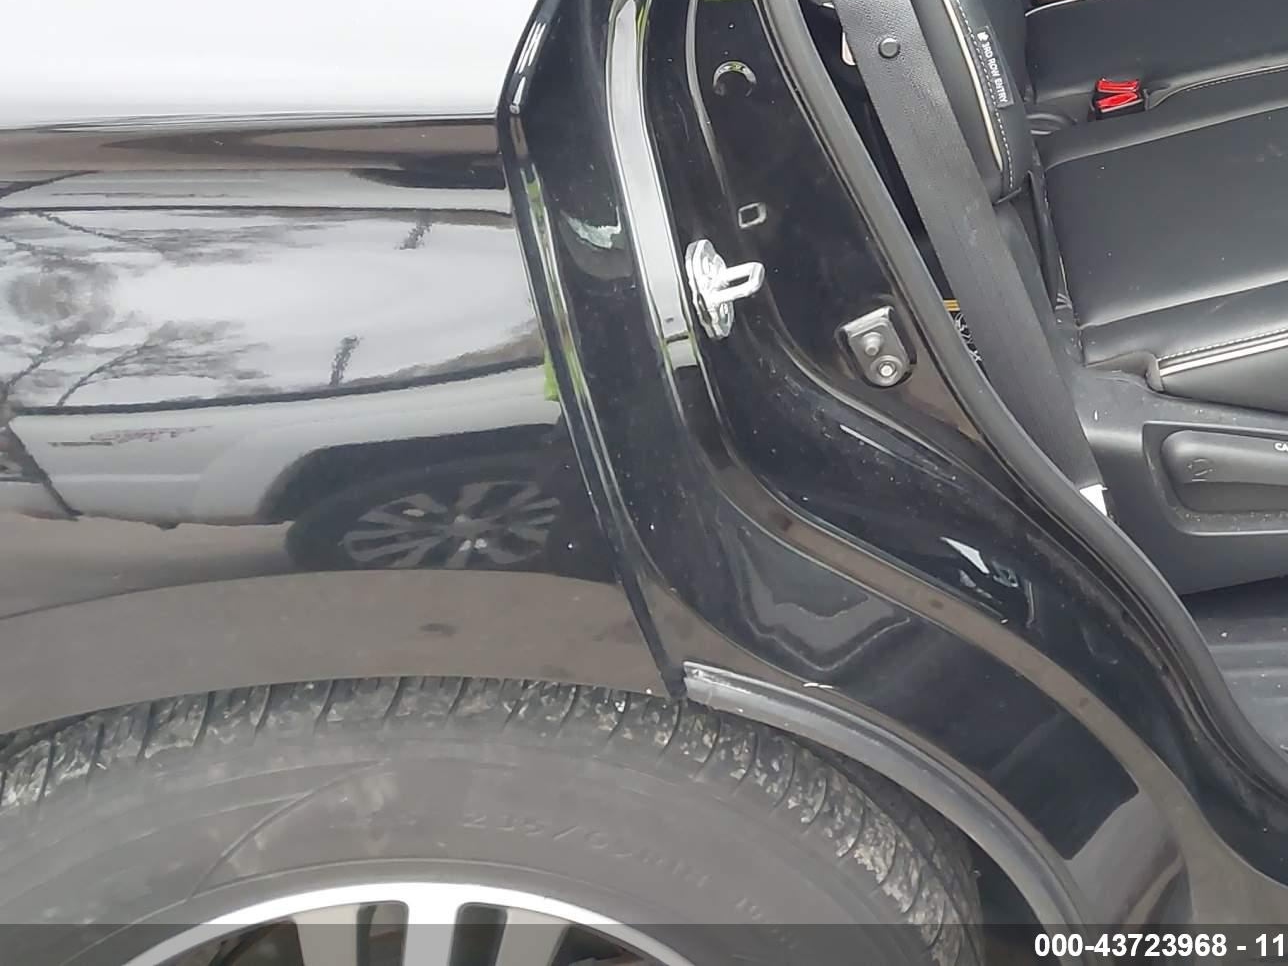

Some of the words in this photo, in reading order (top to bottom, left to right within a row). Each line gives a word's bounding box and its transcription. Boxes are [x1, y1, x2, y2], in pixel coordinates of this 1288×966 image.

[982, 41, 993, 58] 3RD
[988, 58, 1000, 76] ROW
[995, 78, 1008, 102] ENTRY
